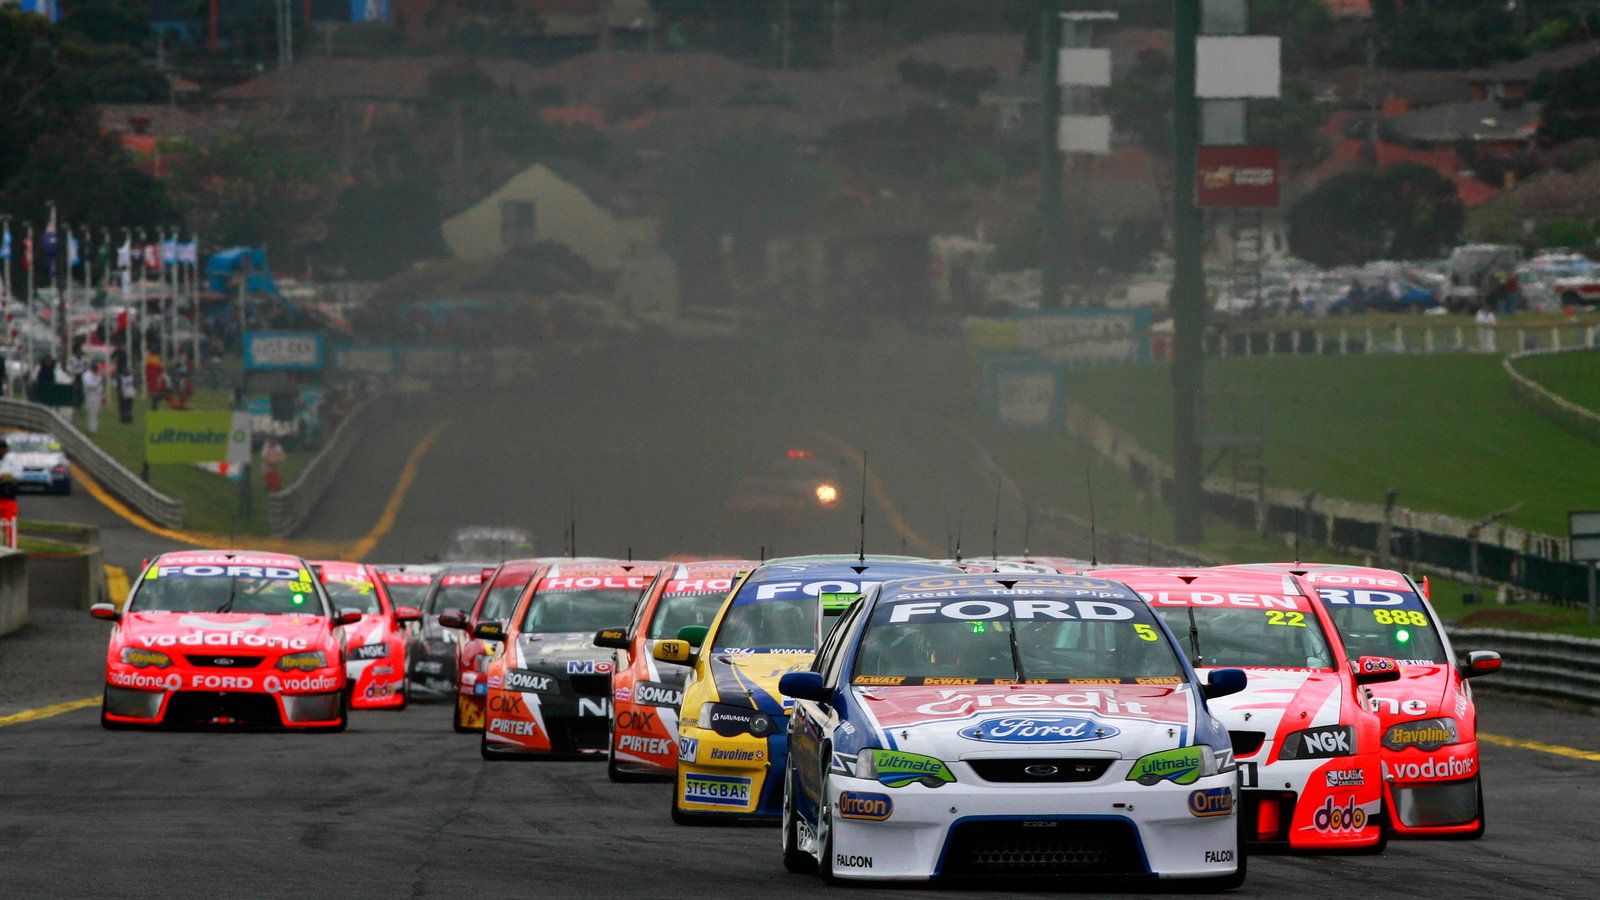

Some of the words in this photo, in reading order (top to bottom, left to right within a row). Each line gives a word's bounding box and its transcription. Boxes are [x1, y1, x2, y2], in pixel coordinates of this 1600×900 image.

[151, 428, 225, 444] ultimate
[165, 556, 295, 566] vodafone
[158, 566, 299, 579] FORD
[288, 581, 313, 592] 88
[897, 590, 958, 601] Steel
[989, 588, 1045, 596] Tube
[1076, 589, 1125, 600] Pipe
[889, 600, 1135, 624] FORD
[1265, 610, 1307, 627] 22
[1373, 609, 1428, 627] 888
[140, 630, 307, 649] vodafone
[602, 630, 624, 639] Hertz
[1133, 623, 1159, 642] 5
[359, 645, 385, 658] NGK
[282, 655, 320, 667] Havoline
[1364, 660, 1395, 673] dodo
[192, 676, 253, 688] FORD
[506, 672, 551, 691] SONAX
[916, 689, 1150, 716] Credit
[490, 718, 537, 736] PIRTEK
[720, 714, 750, 723] NAVMAN
[990, 716, 1087, 738] Ford
[1304, 731, 1350, 754] NGK
[1392, 727, 1450, 743] Havoline
[618, 735, 673, 755] PIRTEK
[711, 748, 754, 761] Havoline
[878, 756, 942, 773] ultimate
[1142, 755, 1199, 774] ultimate
[686, 781, 748, 799] STEGBAR
[841, 793, 886, 815] Orrcon
[1314, 796, 1367, 831] dodo
[837, 854, 872, 868] FALCON
[1205, 851, 1234, 863] FALCON
